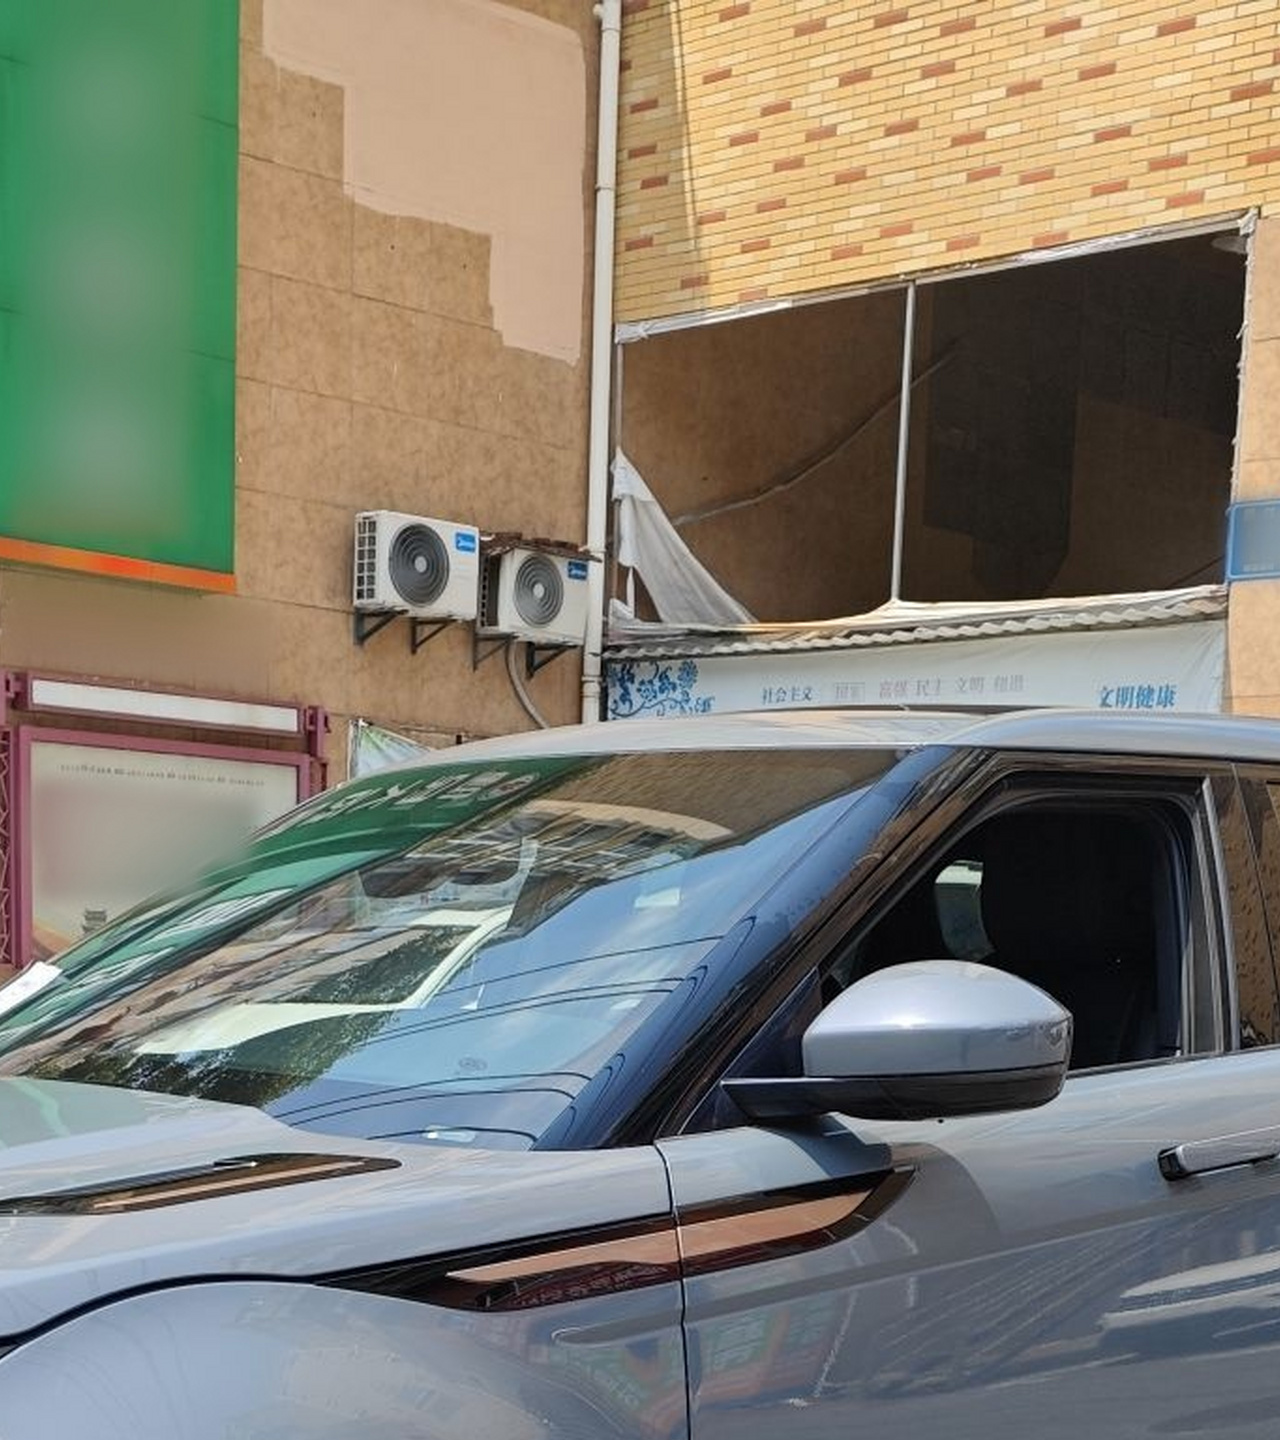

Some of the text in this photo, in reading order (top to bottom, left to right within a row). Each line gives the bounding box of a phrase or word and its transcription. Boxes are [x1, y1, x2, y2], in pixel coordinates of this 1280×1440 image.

[762, 686, 812, 705] 社会主义
[955, 675, 985, 695] 文明
[1099, 683, 1177, 709] 文明健康
